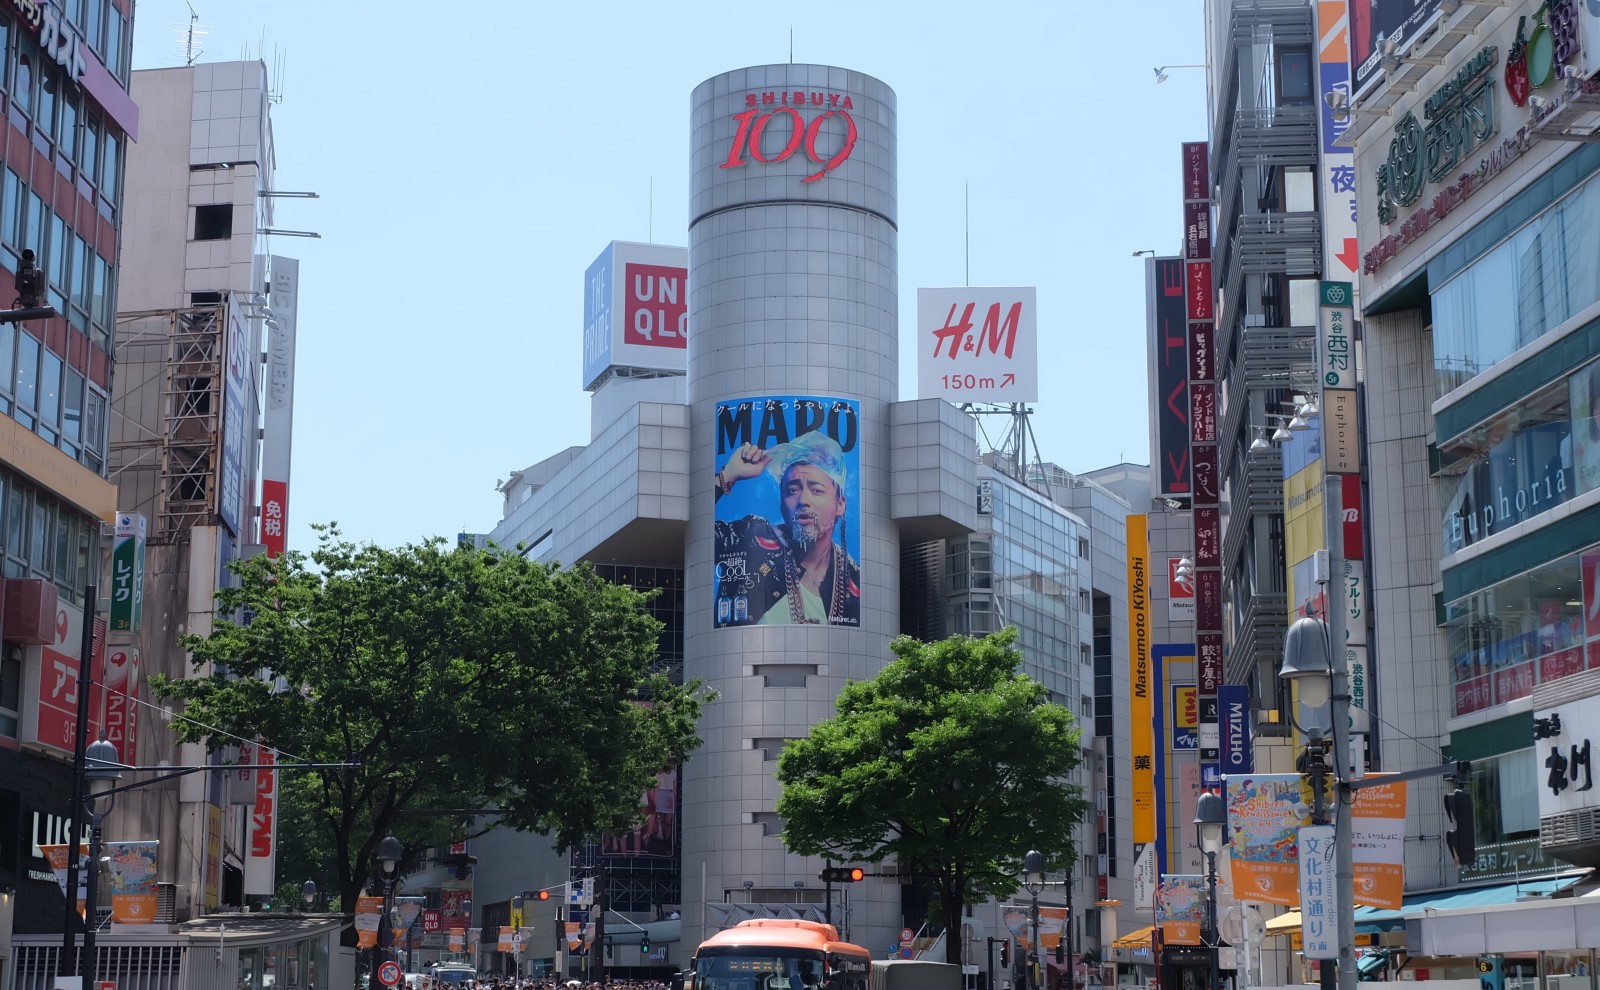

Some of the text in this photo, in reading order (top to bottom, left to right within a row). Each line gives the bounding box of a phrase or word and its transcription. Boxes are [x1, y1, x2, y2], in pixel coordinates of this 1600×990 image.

[41, 4, 86, 83] ガスト
[745, 92, 854, 110] SHIBUYA
[719, 107, 858, 184] 109
[591, 266, 606, 319] THE
[585, 309, 609, 367] PRIME
[932, 301, 1022, 361] H&M
[1327, 310, 1349, 371] 渋谷西村
[941, 374, 995, 390] 150m
[717, 397, 858, 417] クールになっちゃいなよ。
[1205, 393, 1215, 441] インド料理店
[1335, 395, 1348, 458] Euphoria
[264, 500, 282, 537] 免税
[1451, 464, 1567, 544] Euphoria
[115, 559, 132, 602] レイク
[1350, 577, 1361, 619] フルーツ
[117, 619, 130, 629] 3F
[1134, 556, 1146, 698] Matsumoto KiYoshi
[52, 660, 79, 704] アコ
[1201, 644, 1217, 690] 餃子屋台
[1352, 664, 1364, 708] 渋谷西村
[63, 720, 76, 745] 3F
[107, 695, 124, 741] アコム
[1230, 702, 1243, 766] MIZUHO
[1134, 755, 1151, 770] 薬
[1239, 804, 1288, 820] Renaissance
[1248, 798, 1284, 812] Shibuya
[1304, 836, 1325, 938] 文化村通り
[424, 912, 438, 921] UNI
[424, 921, 439, 930] QLO
[1308, 941, 1328, 952] 方面
[1480, 962, 1488, 972] 6
